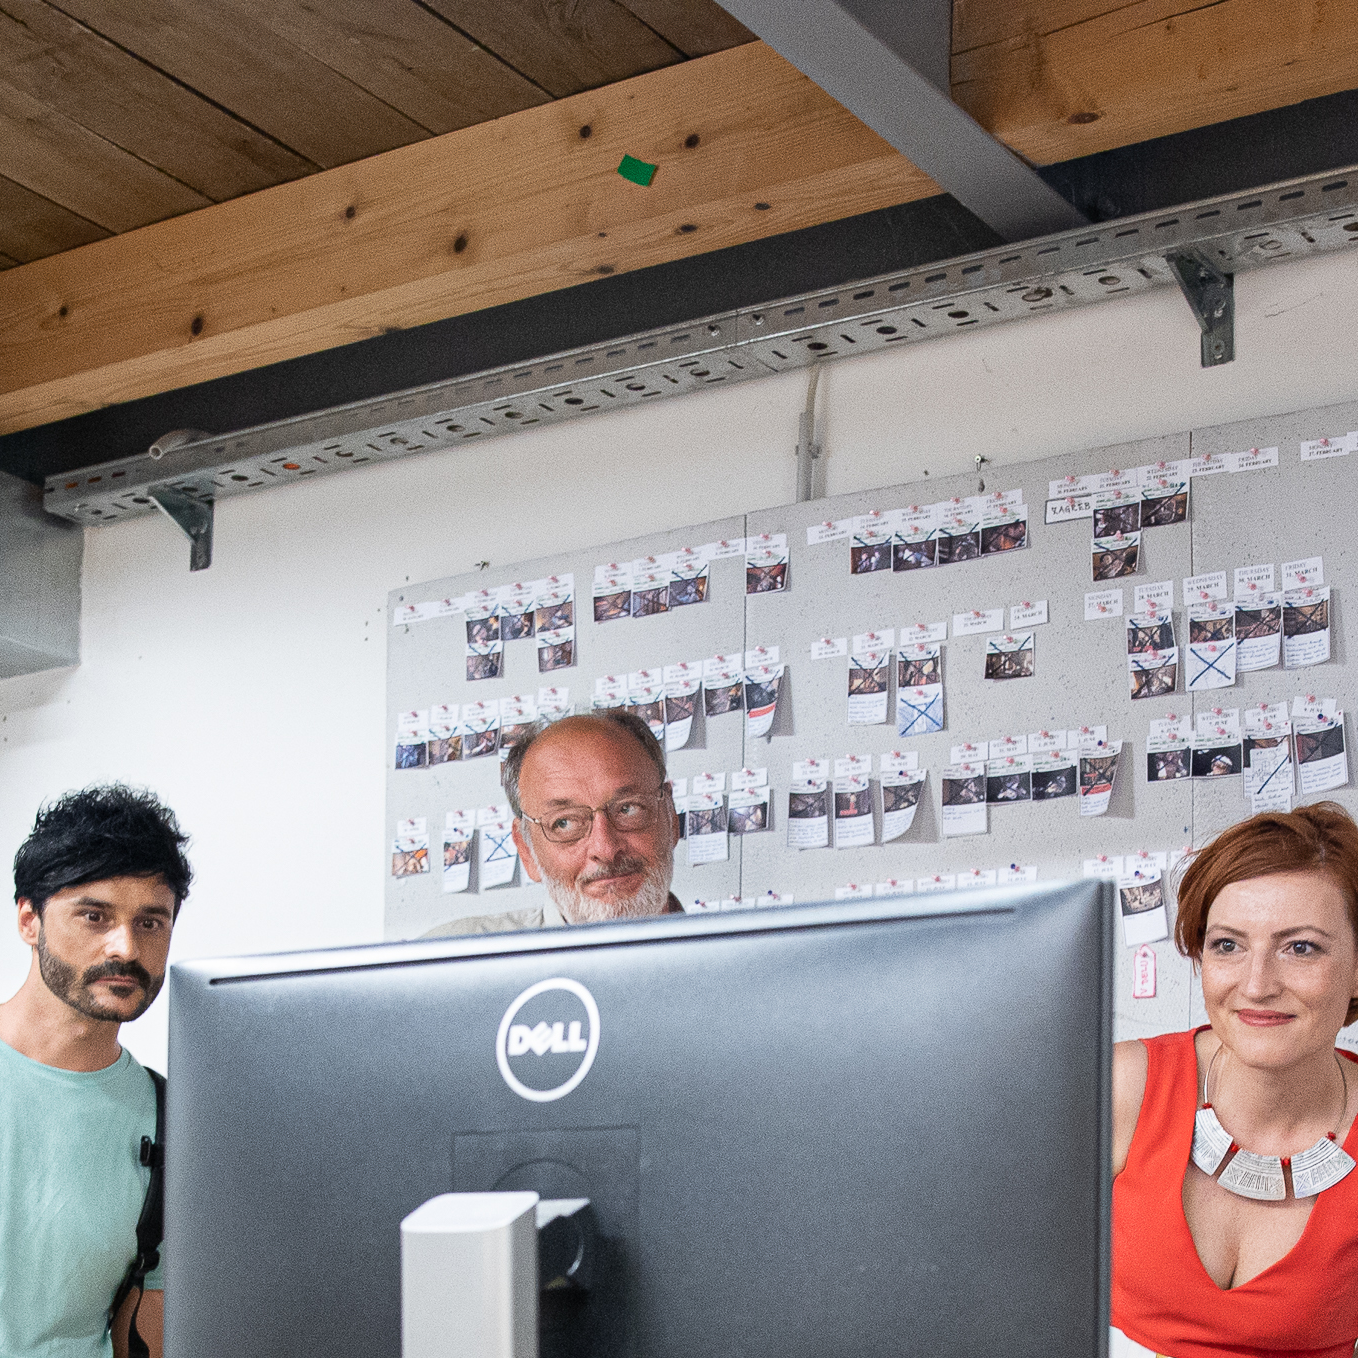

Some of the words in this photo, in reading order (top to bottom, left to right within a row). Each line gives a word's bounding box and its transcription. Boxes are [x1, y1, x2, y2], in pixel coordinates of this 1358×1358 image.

[1295, 568, 1318, 576] MARCH
[1197, 582, 1219, 590] MARCH
[1147, 591, 1169, 599] MARCH
[507, 1020, 588, 1057] DELL
